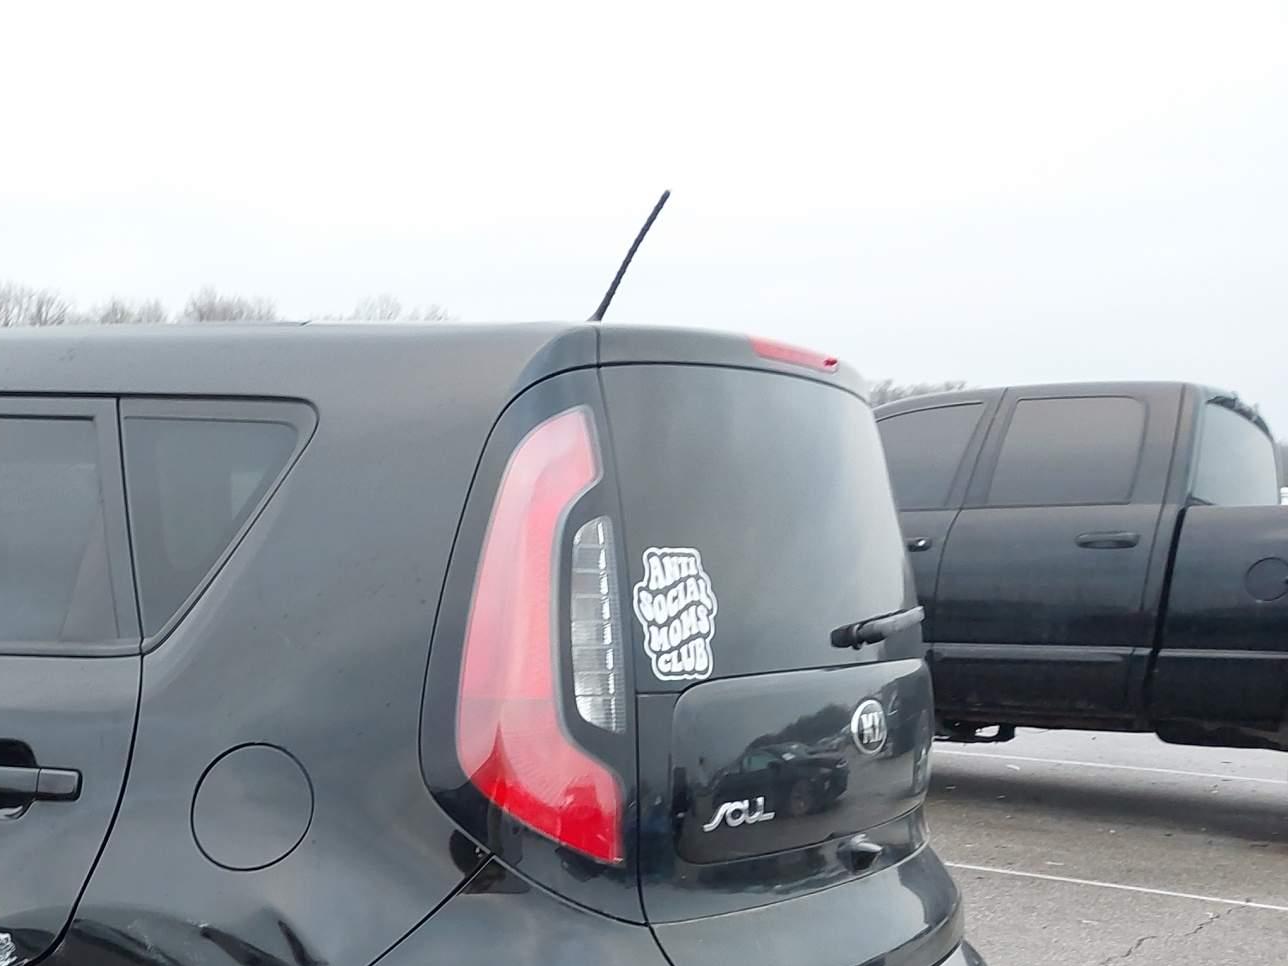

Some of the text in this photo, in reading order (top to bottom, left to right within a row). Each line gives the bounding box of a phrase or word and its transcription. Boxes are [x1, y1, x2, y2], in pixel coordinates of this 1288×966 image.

[648, 555, 698, 590] ANTI
[639, 577, 712, 625] SOCIAL
[649, 604, 710, 652] MOMS
[657, 638, 708, 673] CLUB
[703, 796, 775, 832] SOUL
